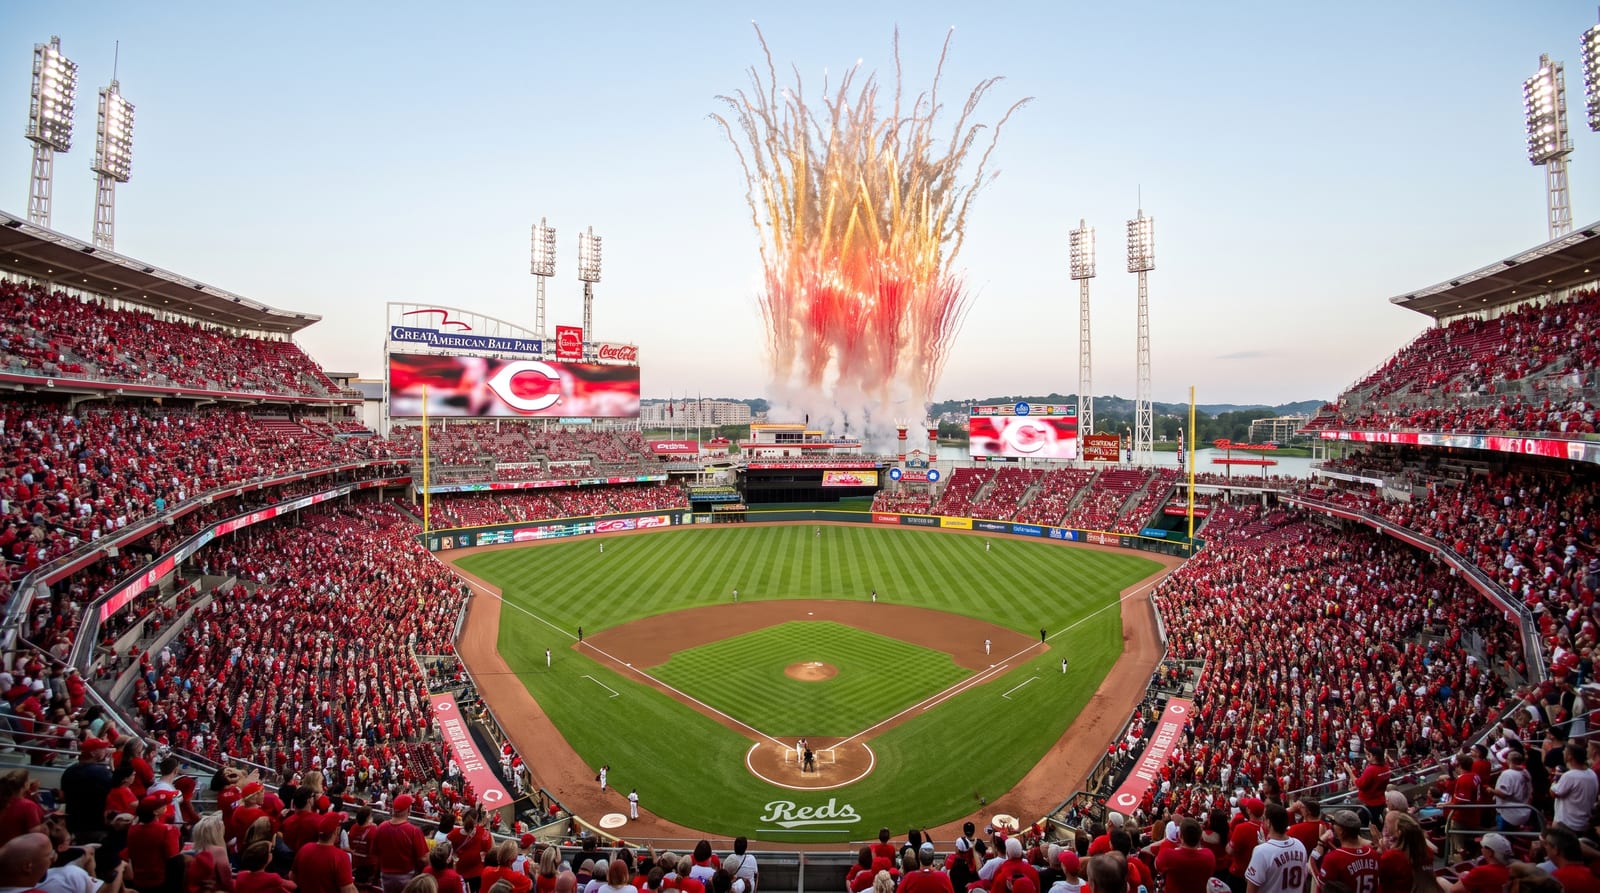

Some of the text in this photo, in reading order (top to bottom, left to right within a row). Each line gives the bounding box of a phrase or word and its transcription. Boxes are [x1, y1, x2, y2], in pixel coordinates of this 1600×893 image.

[393, 327, 539, 352] GREAT AMERICAN BALL PARK
[760, 798, 861, 829] Reds
[1356, 874, 1374, 893] 15
